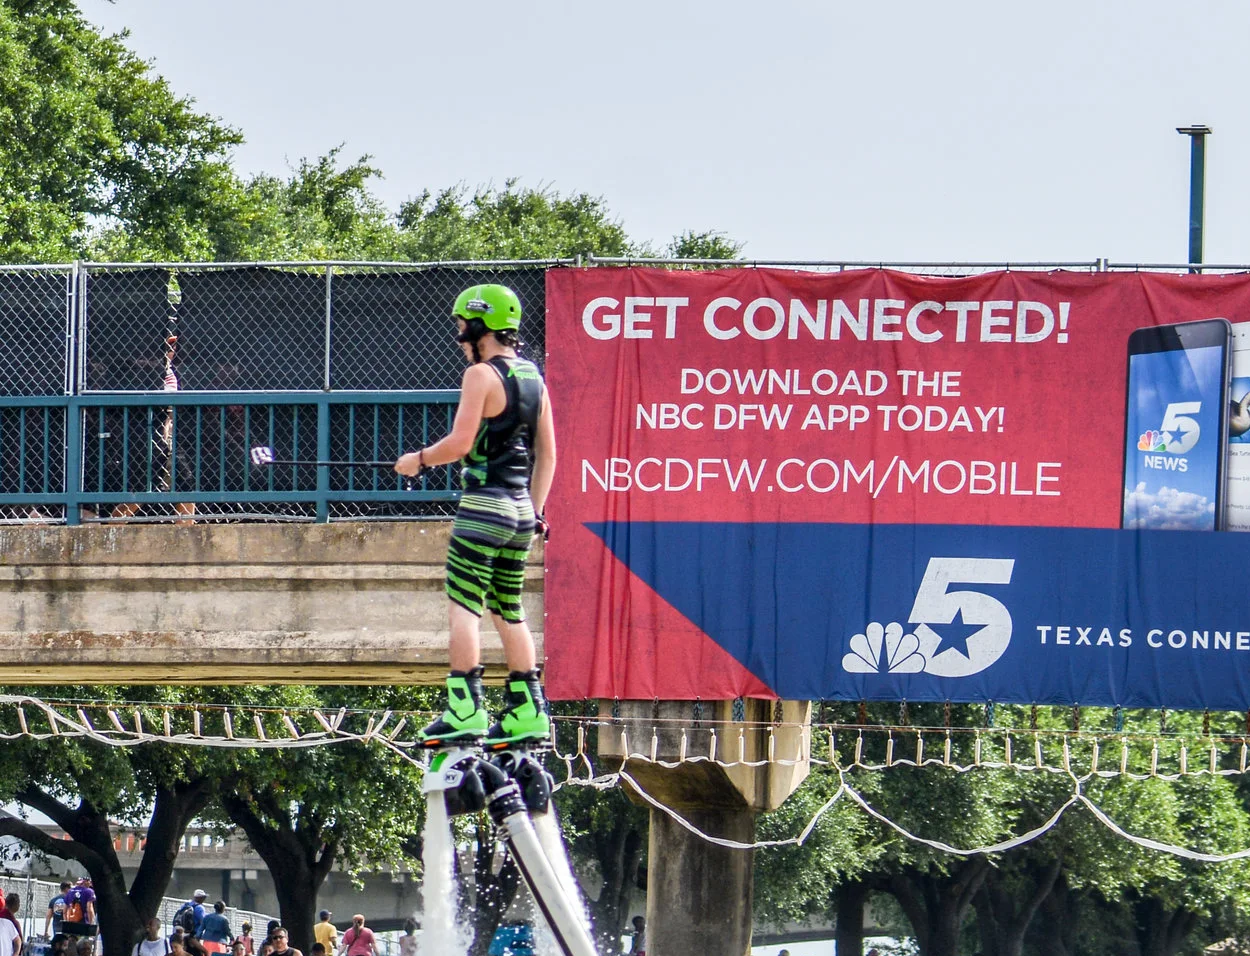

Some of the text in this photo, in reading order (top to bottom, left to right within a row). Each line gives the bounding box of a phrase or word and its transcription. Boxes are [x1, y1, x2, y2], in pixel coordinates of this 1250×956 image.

[581, 296, 1071, 344] GET CONNECTED!
[680, 368, 962, 397] DOWNLOAD THE
[635, 403, 1006, 433] NBC DFW APP TODAY!
[1160, 401, 1202, 454] 5
[581, 455, 1062, 499] NBCDFW.COM/MOBILE
[1144, 454, 1189, 472] NEWS
[908, 556, 1016, 678] 5
[1036, 625, 1133, 647] TEXAS
